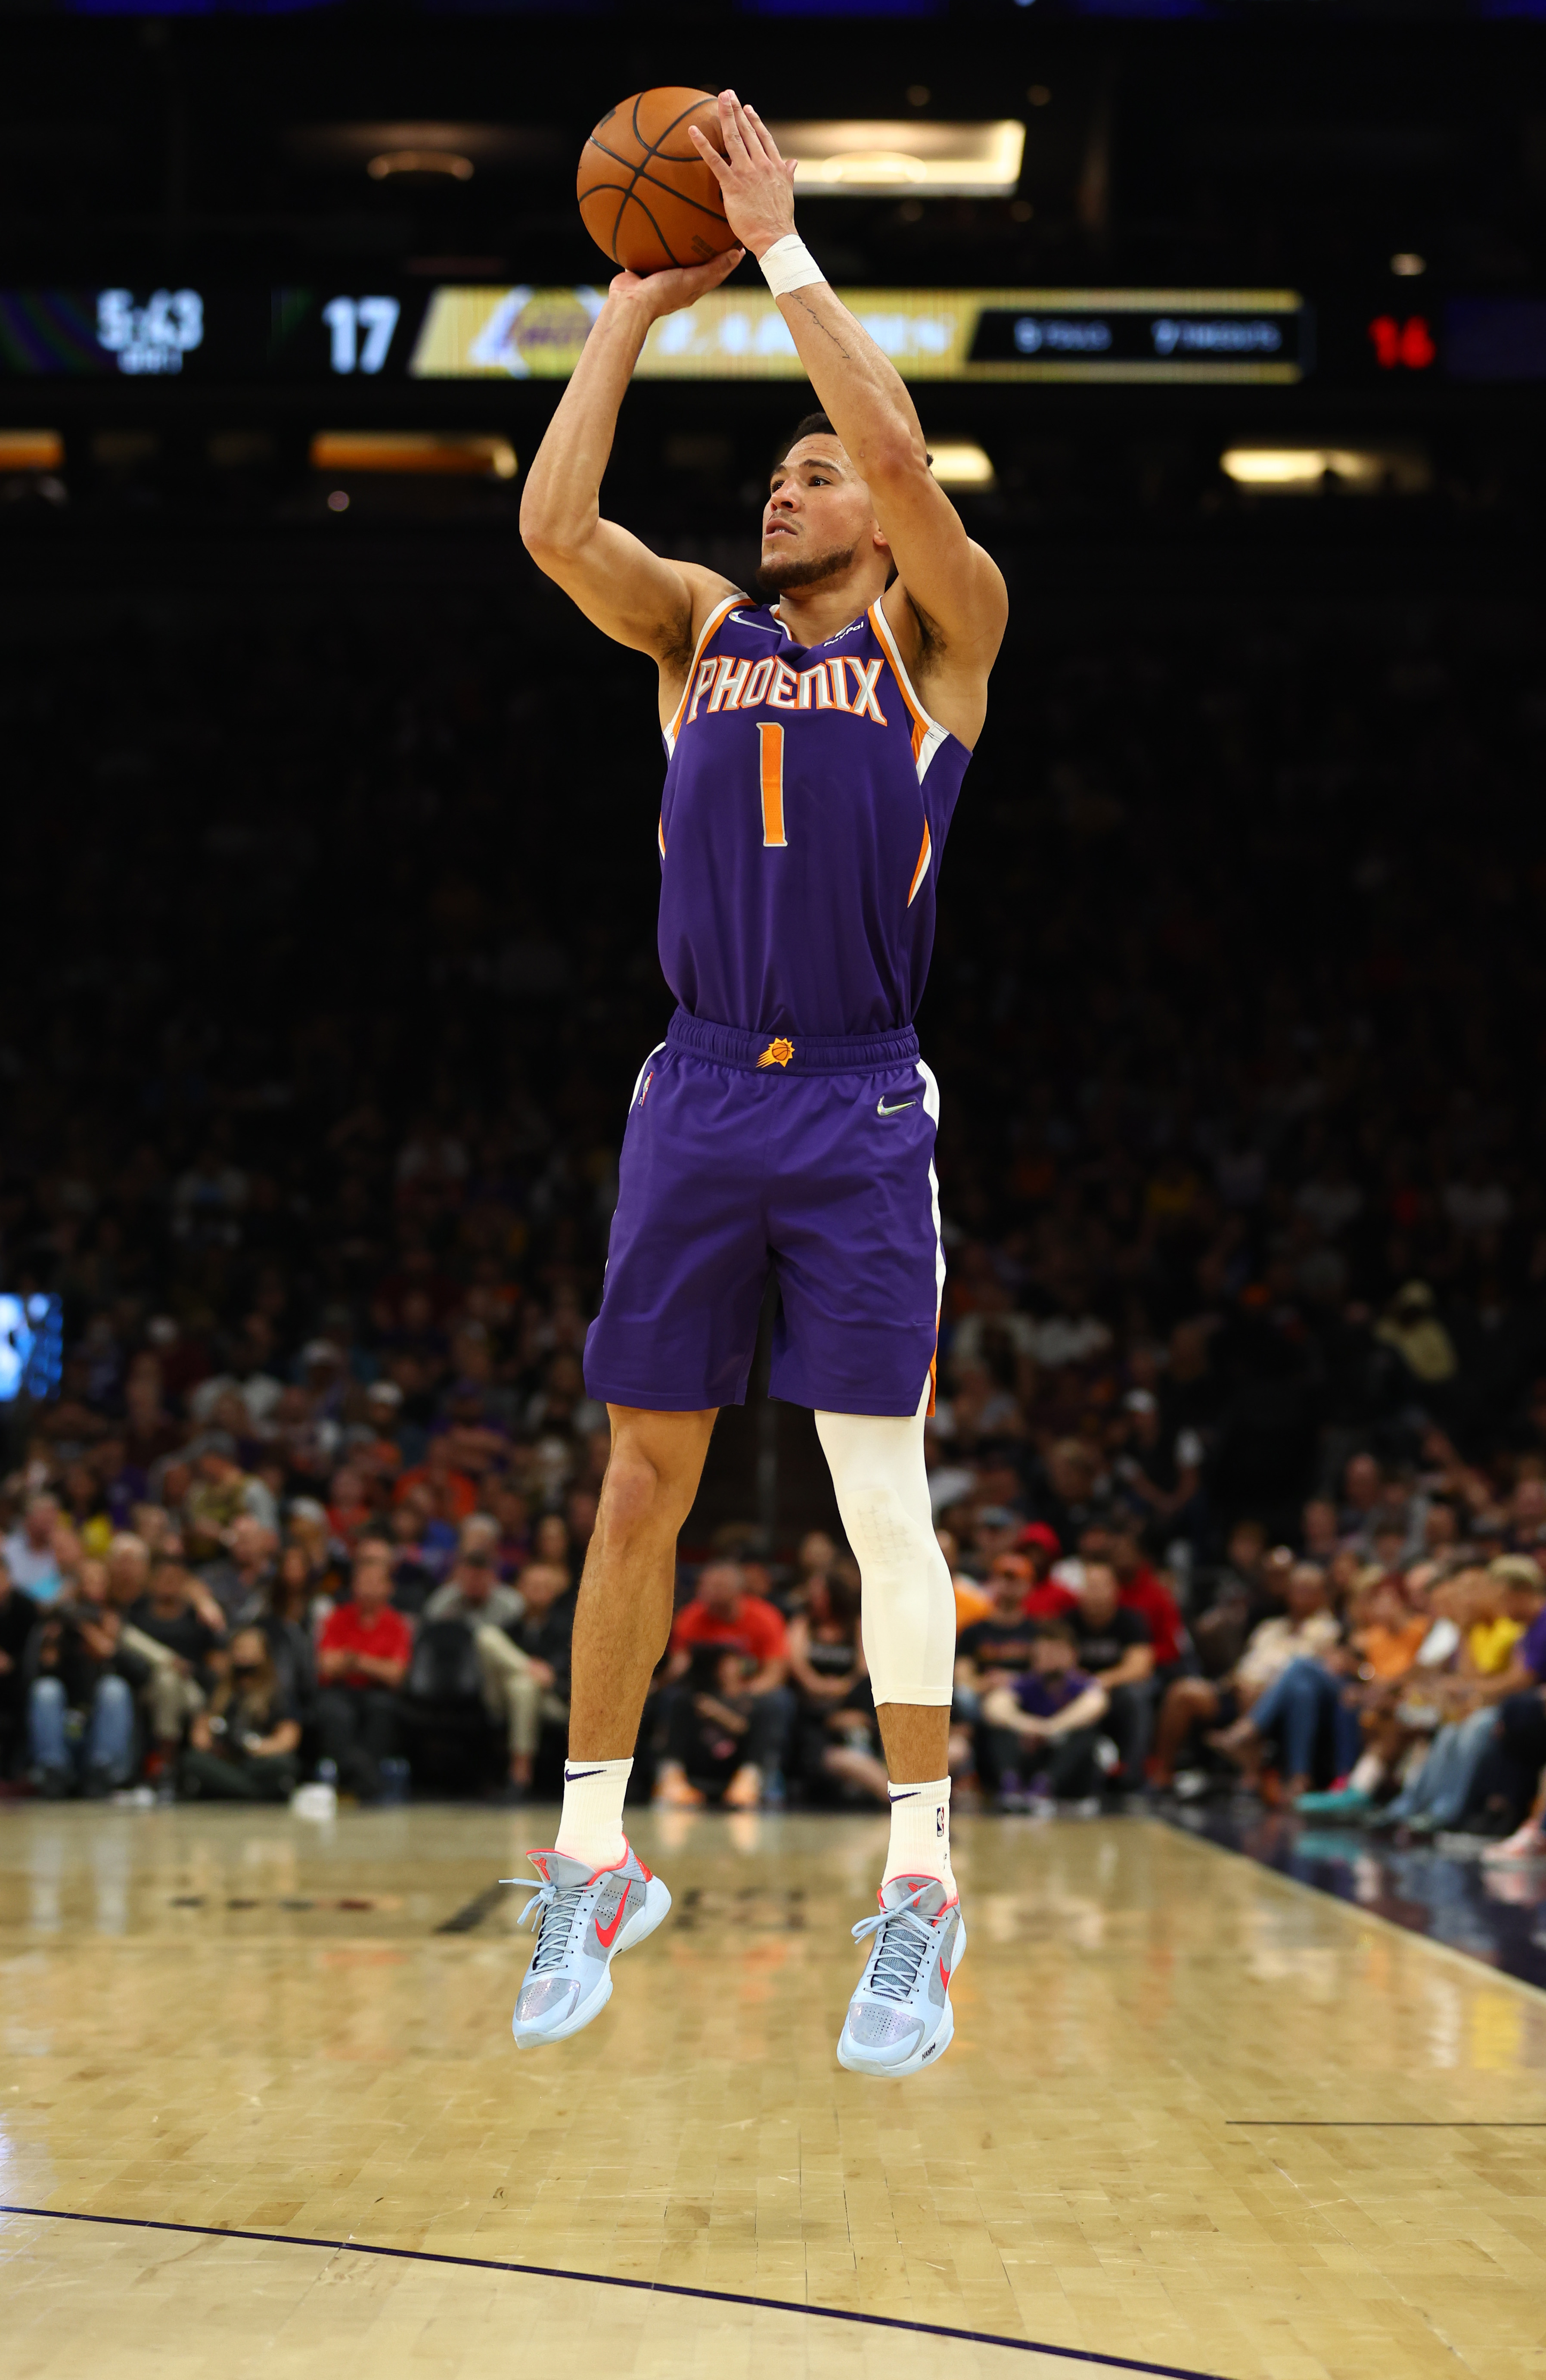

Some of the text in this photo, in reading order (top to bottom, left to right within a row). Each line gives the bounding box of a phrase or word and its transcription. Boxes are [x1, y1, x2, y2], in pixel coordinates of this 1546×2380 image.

[323, 296, 400, 374] 17
[823, 621, 864, 647] PayPal
[686, 655, 888, 727] PHOENIX
[756, 722, 788, 847] 1
